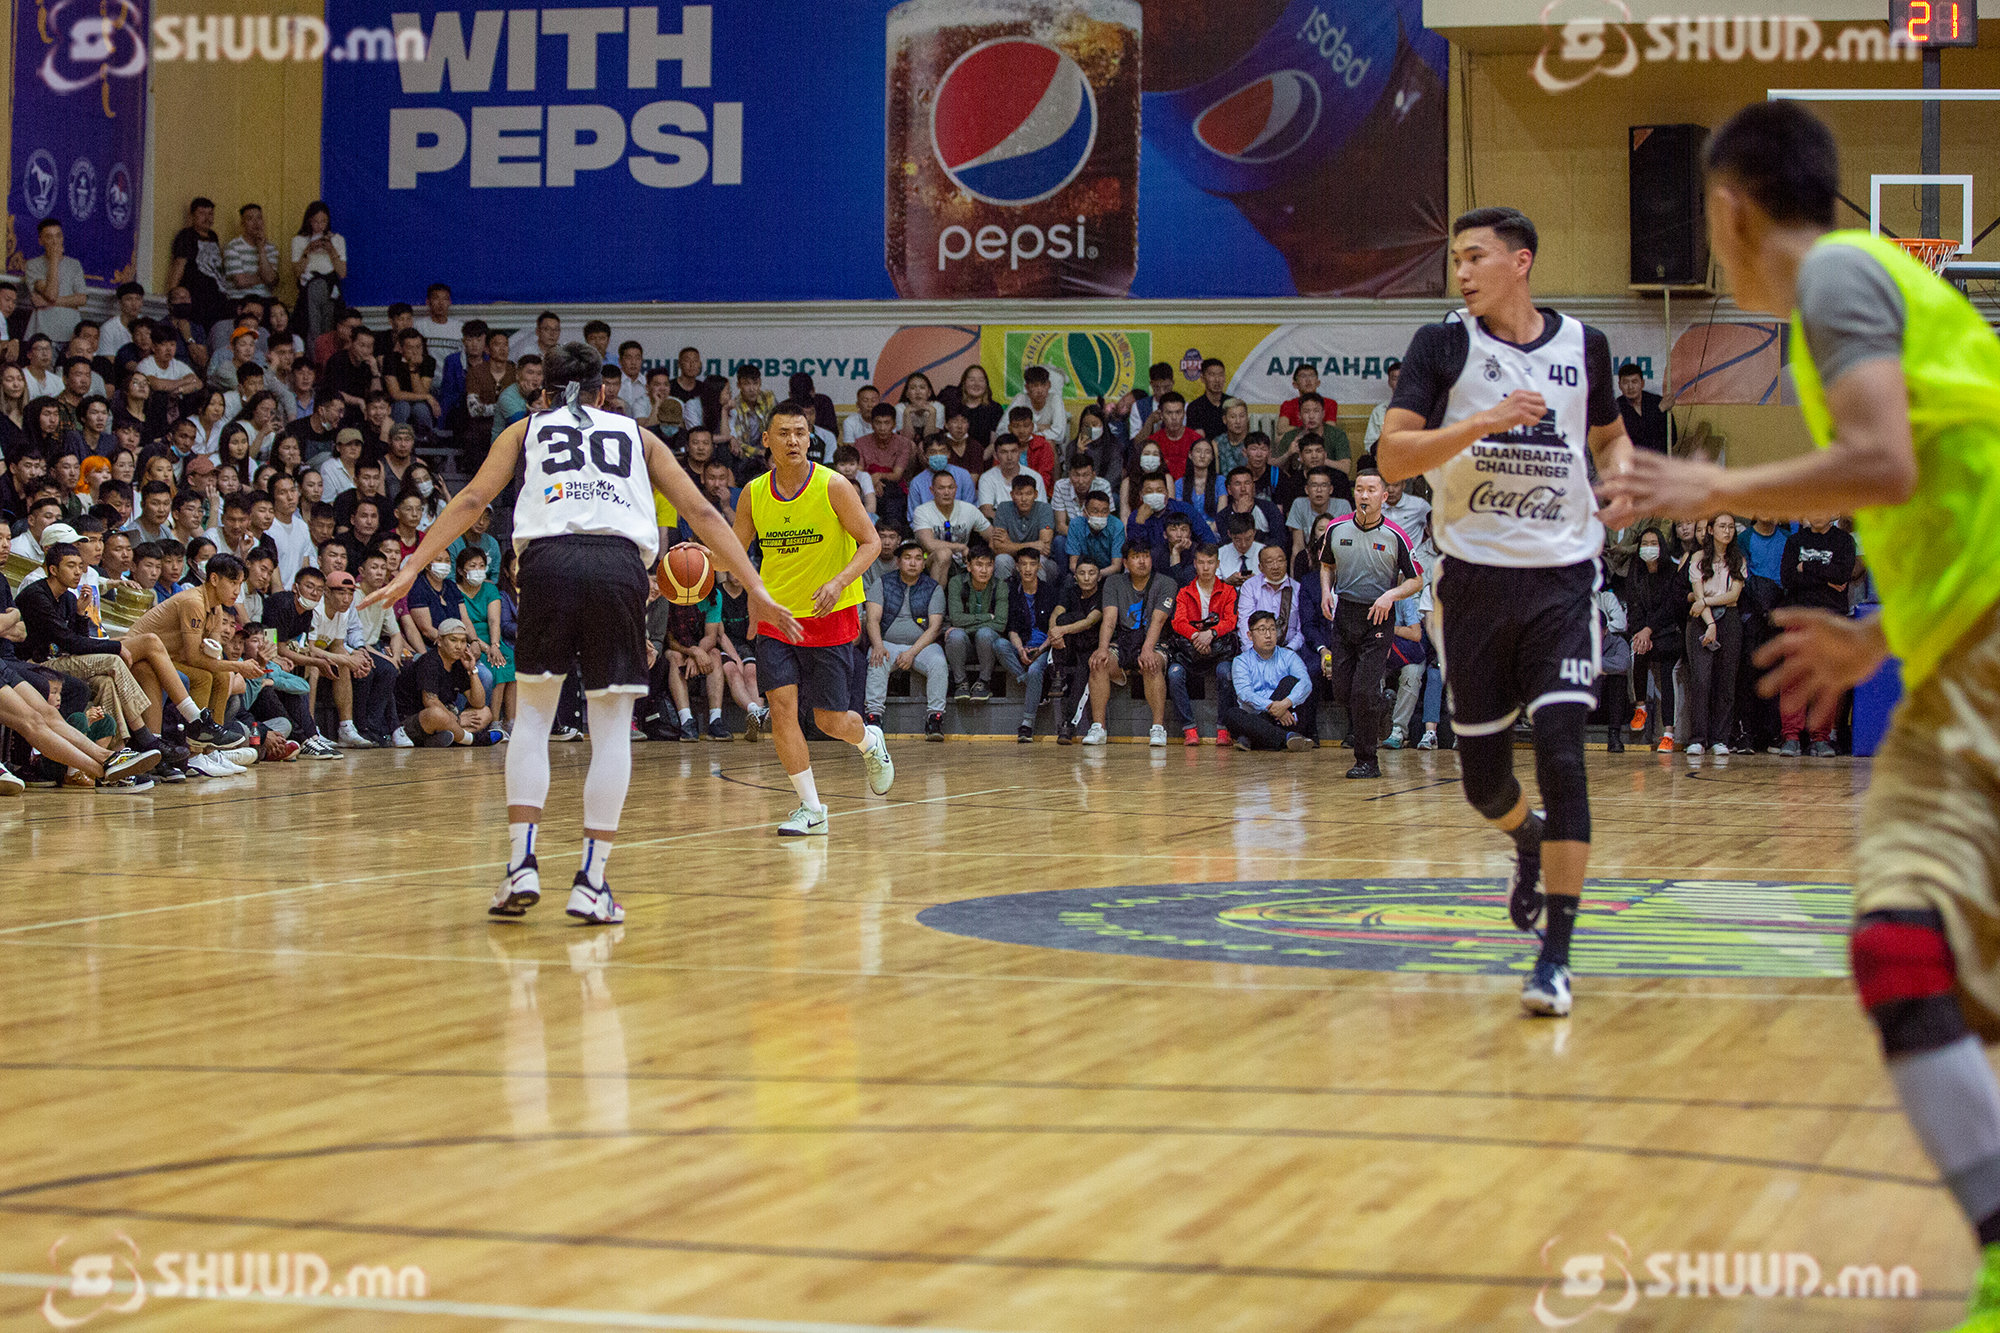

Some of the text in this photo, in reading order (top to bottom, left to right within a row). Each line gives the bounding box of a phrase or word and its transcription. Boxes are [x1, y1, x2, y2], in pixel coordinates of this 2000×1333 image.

[1908, 1, 1959, 42] 21
[391, 4, 712, 94] WITH
[1296, 5, 1372, 89] pepsi
[388, 100, 743, 190] PEPSI
[938, 214, 1086, 271] pepsi
[1549, 364, 1578, 387] 40
[537, 425, 633, 478] 30
[1471, 445, 1574, 465] ULAANBAATAR
[1475, 460, 1569, 479] CHALLENGER
[766, 528, 814, 538] MONGOLIAN
[1559, 658, 1593, 687] 40
